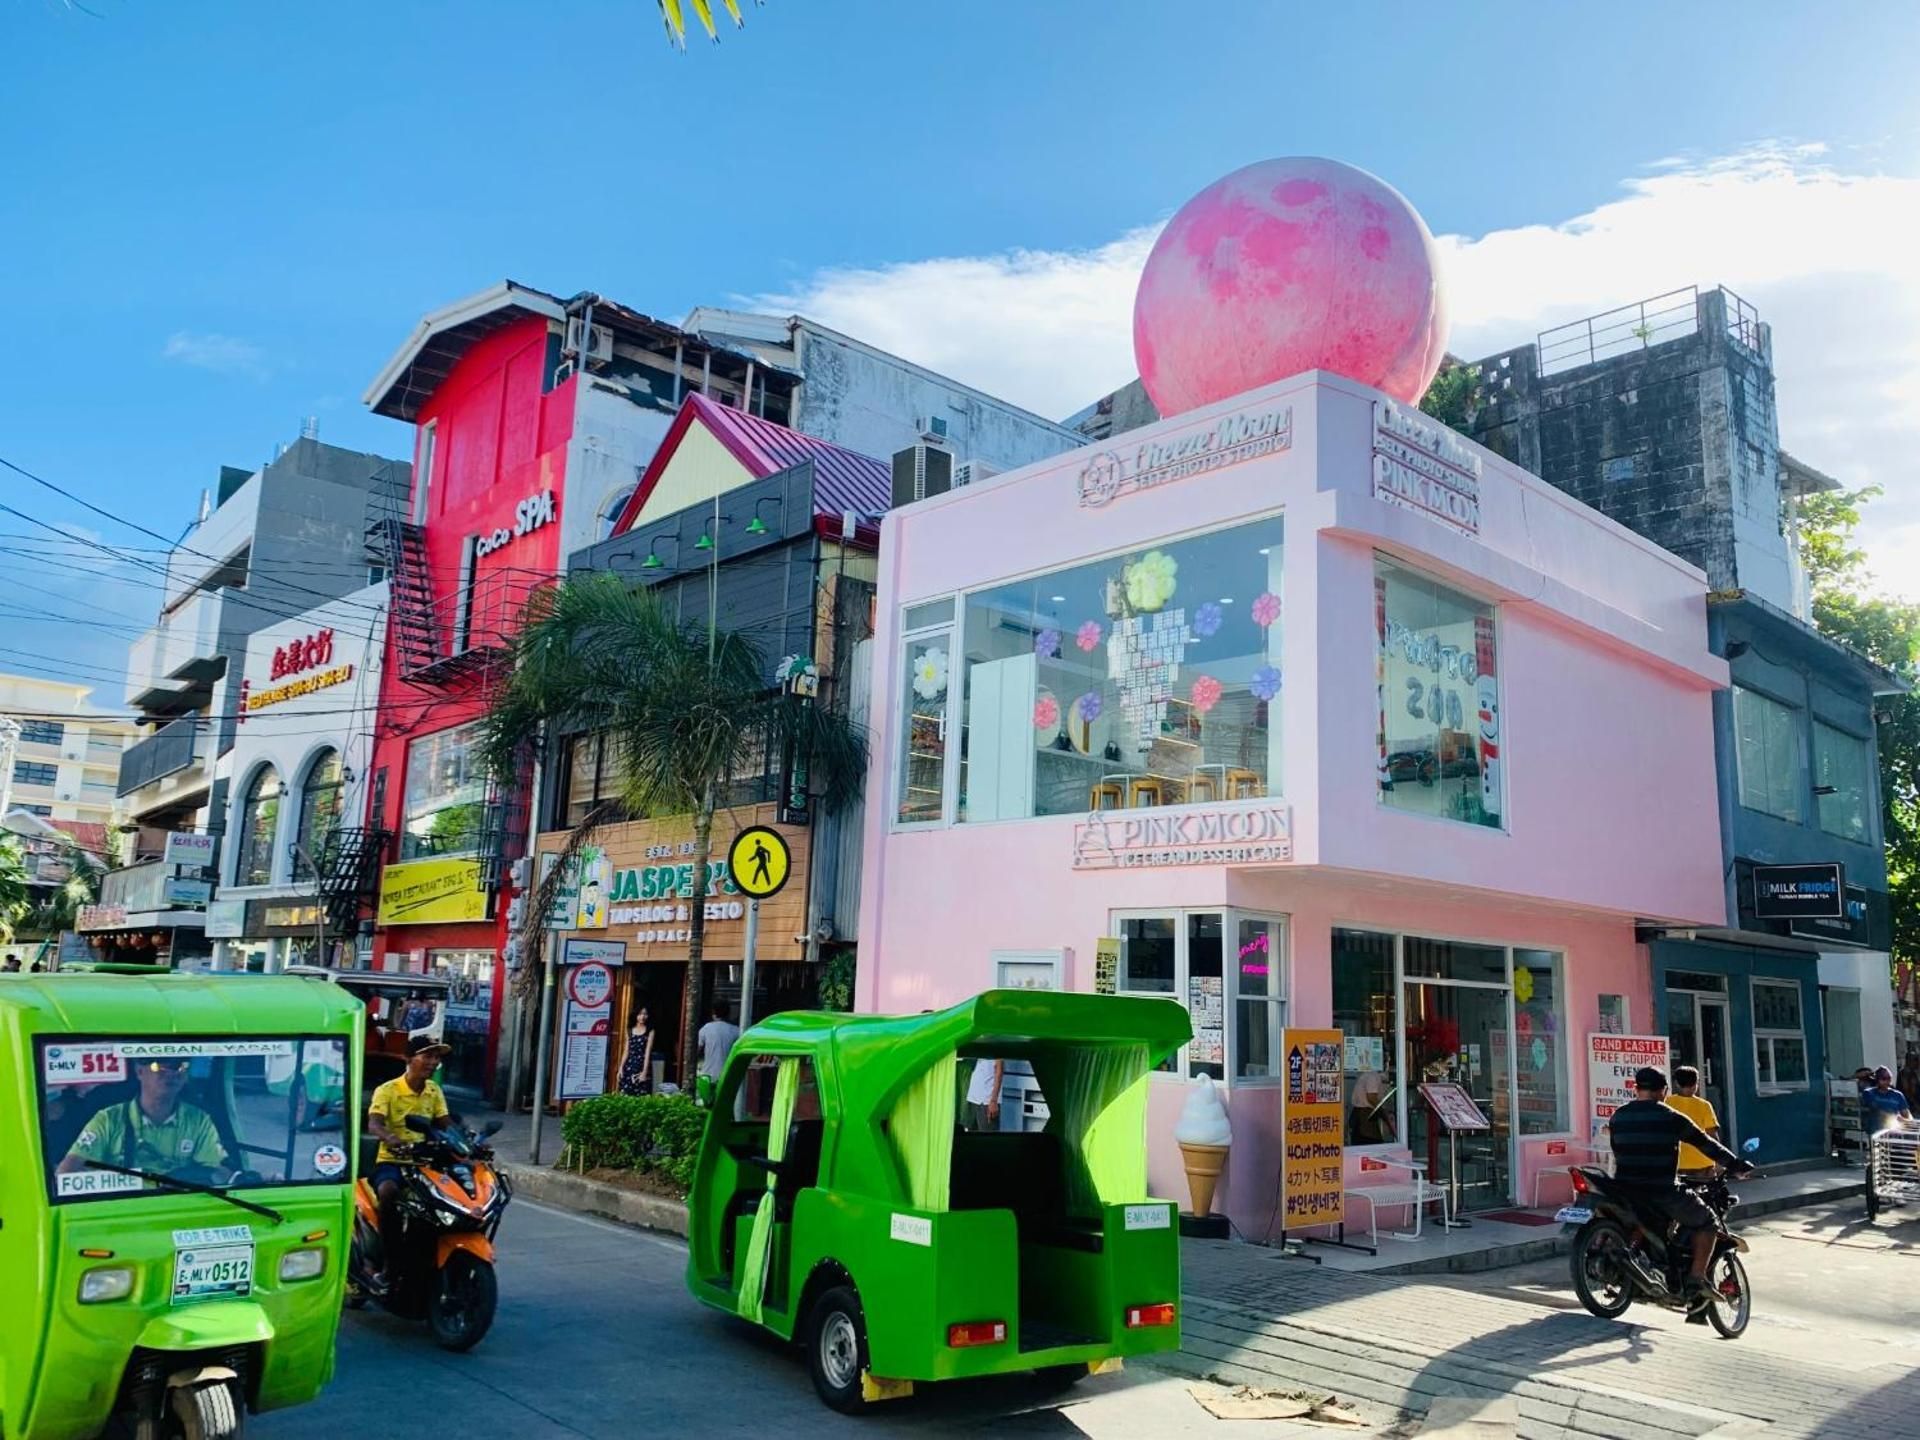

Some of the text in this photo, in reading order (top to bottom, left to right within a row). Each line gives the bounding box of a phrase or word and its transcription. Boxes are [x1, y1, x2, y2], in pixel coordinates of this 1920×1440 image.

[1135, 408, 1290, 470] Cheeze Moon
[1170, 454, 1220, 480] PHOTO
[1377, 455, 1424, 500] PINK
[513, 489, 554, 537] SPA
[1406, 677, 1463, 730] 200
[1124, 807, 1291, 847] PINK MOON
[1252, 846, 1291, 861] CAFE
[1770, 881, 1838, 893] MILK FRIDGE
[610, 904, 675, 924] TAPSILOG
[691, 901, 744, 921] ESTO
[121, 1045, 203, 1055] CAGBAN
[1594, 1038, 1665, 1053] SAND CASTLE
[48, 1052, 119, 1074] E-MLY 512
[1291, 1056, 1302, 1069] 2F
[1594, 1051, 1665, 1066] FREE COUPON
[1596, 1087, 1614, 1097] BUY
[1287, 1142, 1341, 1160] 4Cut Photo
[62, 1171, 138, 1192] FOR HIRE
[203, 1226, 249, 1242] E-TRIKE
[212, 1260, 249, 1282] 0512
